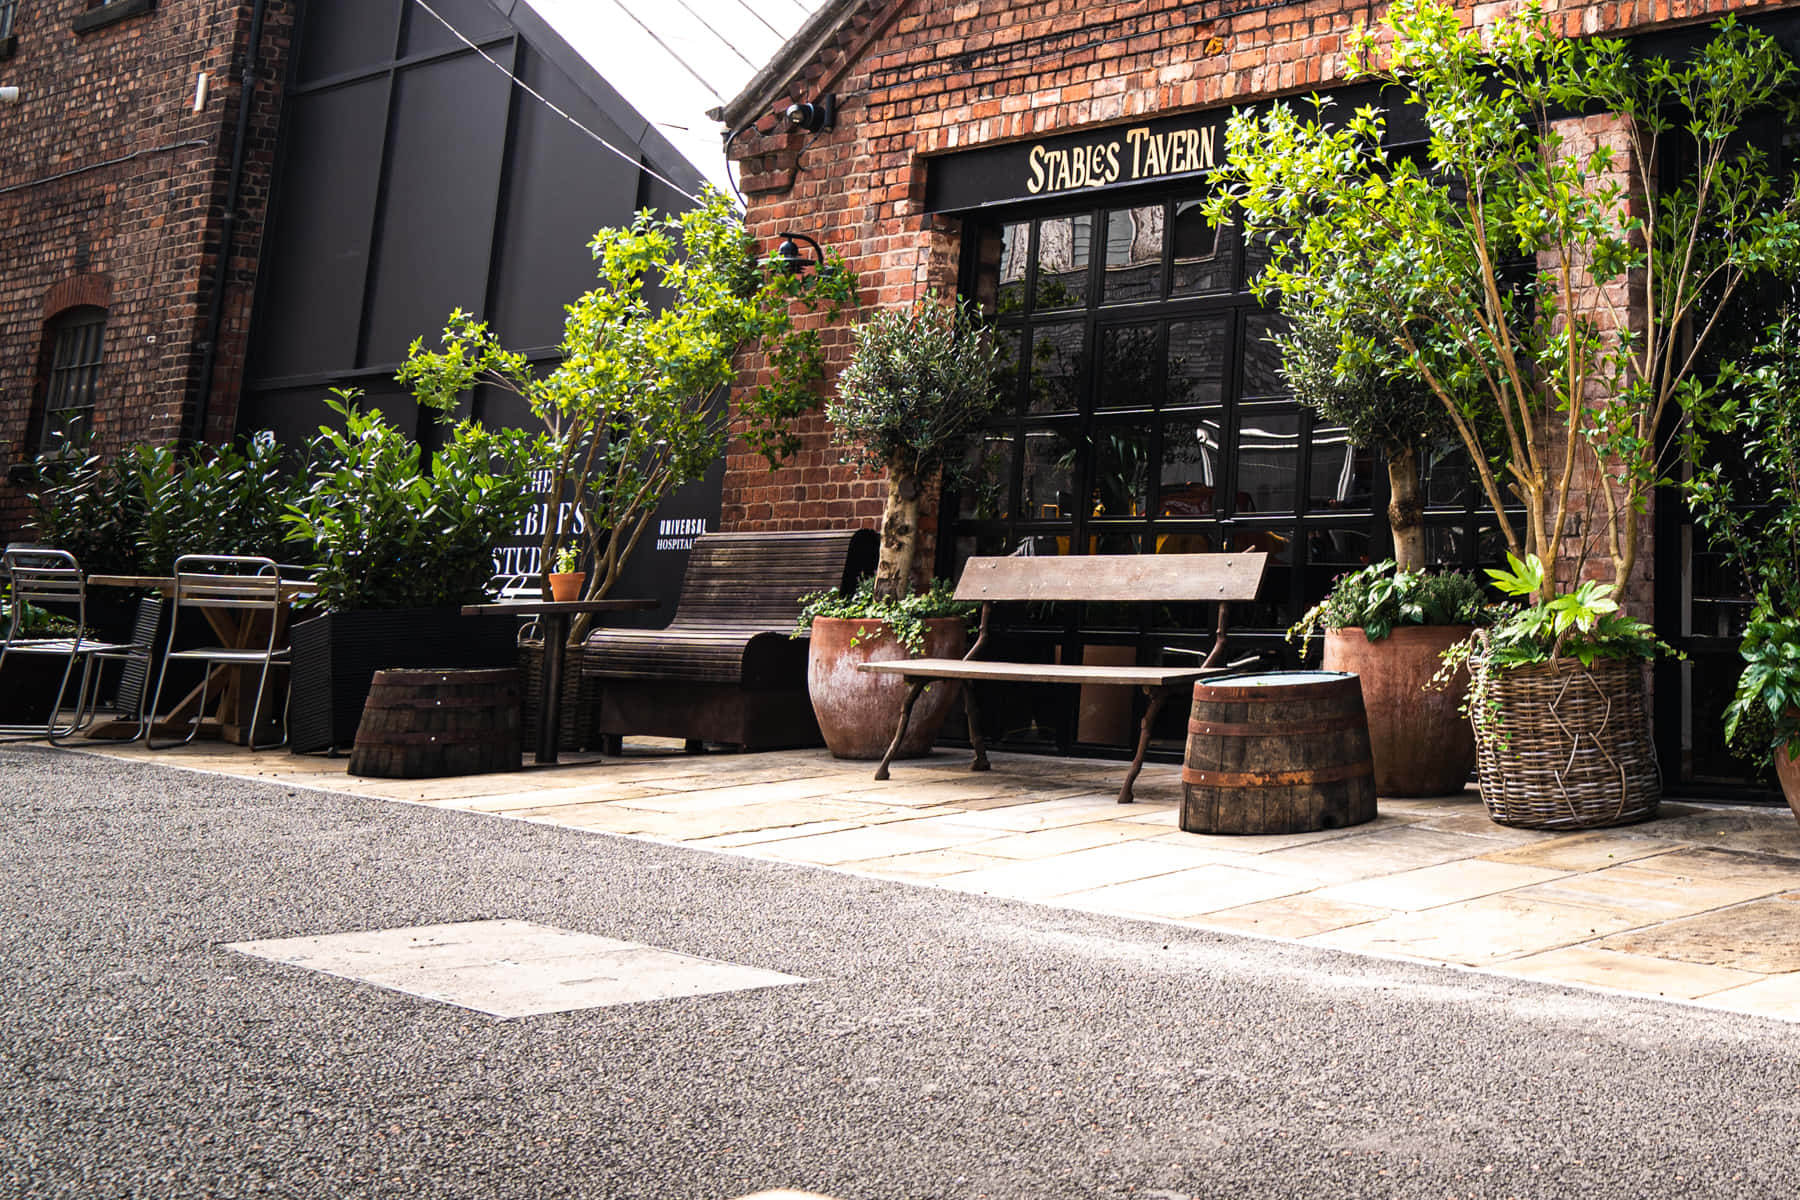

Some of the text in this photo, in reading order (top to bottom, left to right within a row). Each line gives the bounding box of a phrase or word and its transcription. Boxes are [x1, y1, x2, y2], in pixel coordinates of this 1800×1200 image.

[1026, 125, 1216, 194] STABLES TAVERN
[659, 518, 707, 536] UNIVERSAL
